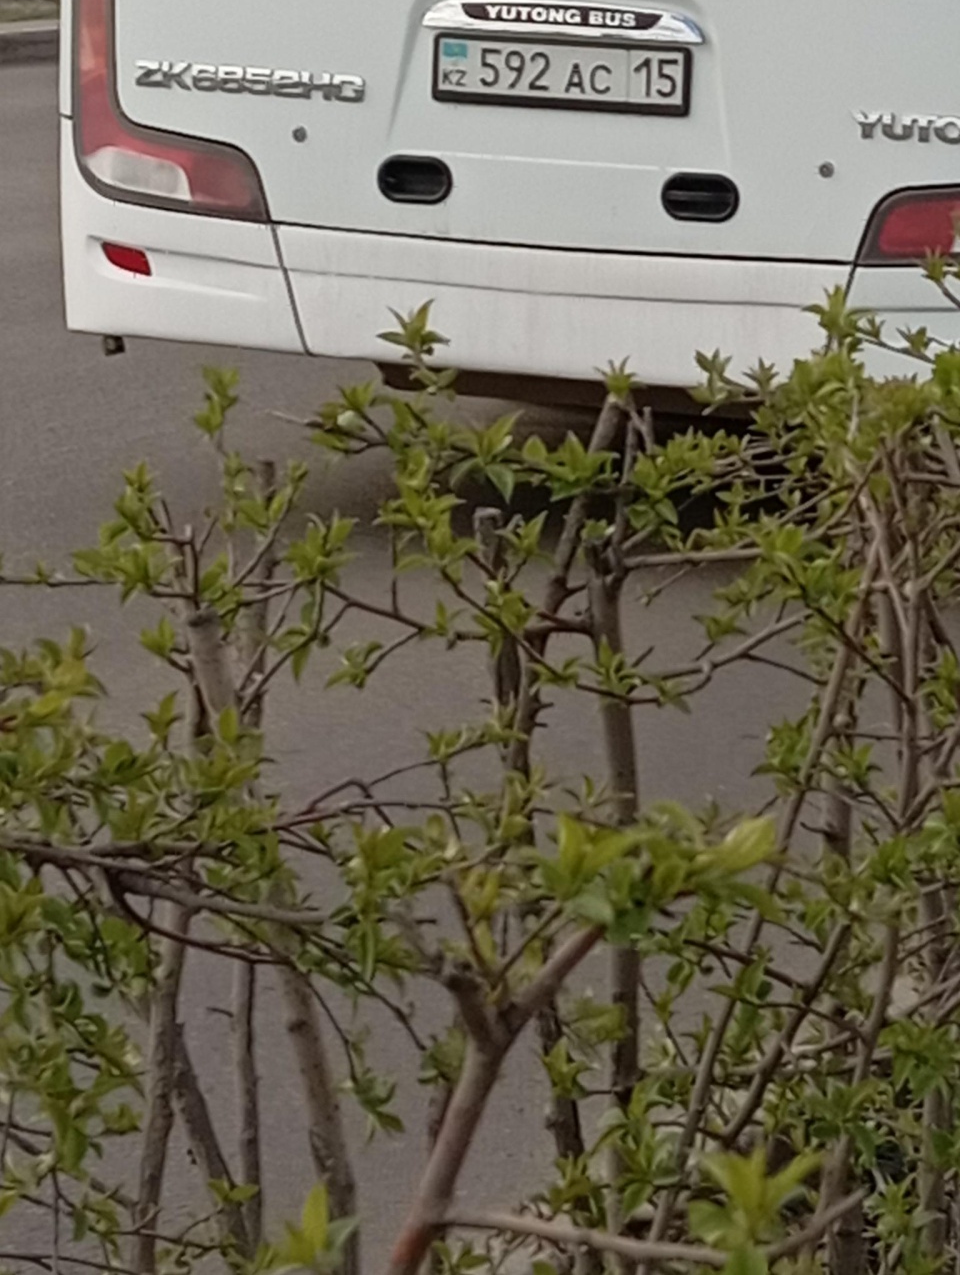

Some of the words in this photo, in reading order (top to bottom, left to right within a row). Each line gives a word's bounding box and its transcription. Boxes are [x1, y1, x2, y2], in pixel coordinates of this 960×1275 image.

[485, 4, 581, 24] YUTONG
[589, 11, 636, 27] BUS
[135, 58, 366, 103] ZK6852HG
[441, 69, 467, 87] KZ
[479, 47, 550, 91] 592
[564, 63, 612, 95] AC
[633, 56, 679, 99] 15
